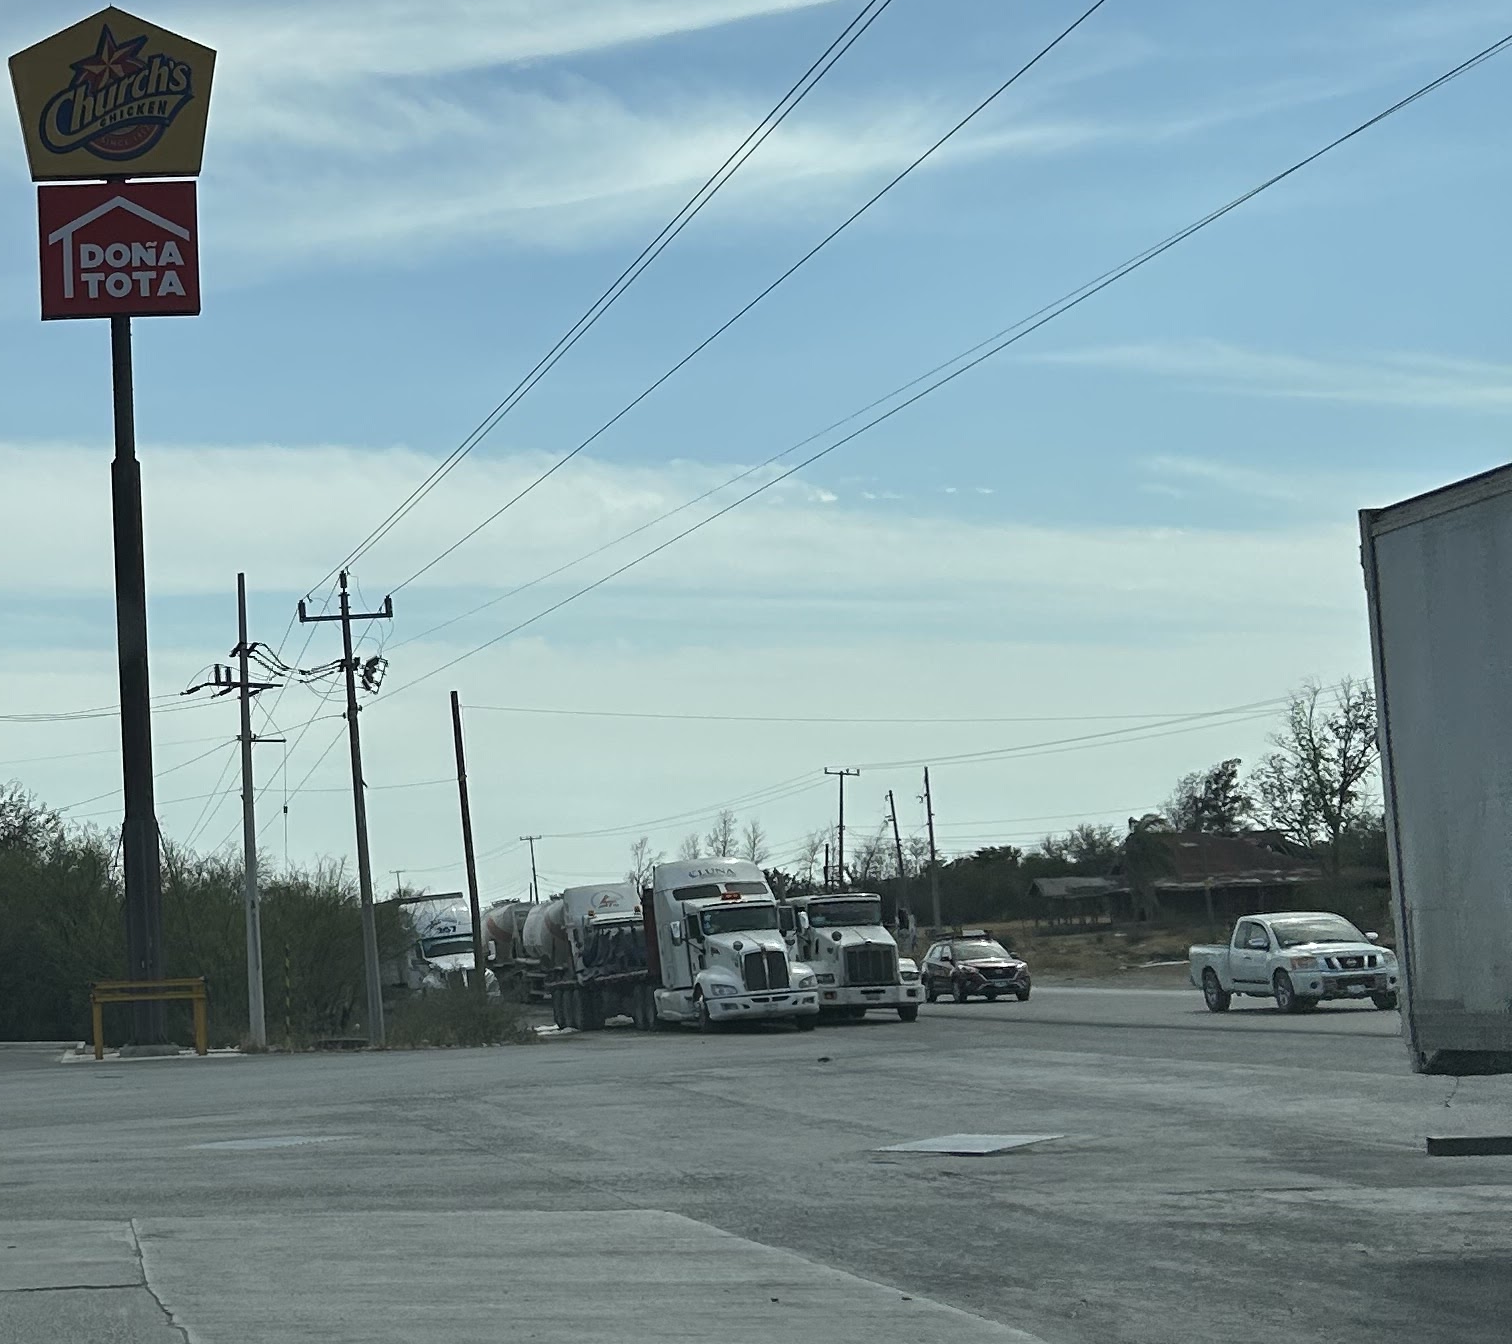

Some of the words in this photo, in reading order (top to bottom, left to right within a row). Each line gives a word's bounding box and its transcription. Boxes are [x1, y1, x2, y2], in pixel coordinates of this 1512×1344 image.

[44, 57, 188, 147] Church's
[99, 99, 168, 127] CHICKEN
[80, 241, 186, 269] DOÑA
[81, 271, 186, 298] TOTA
